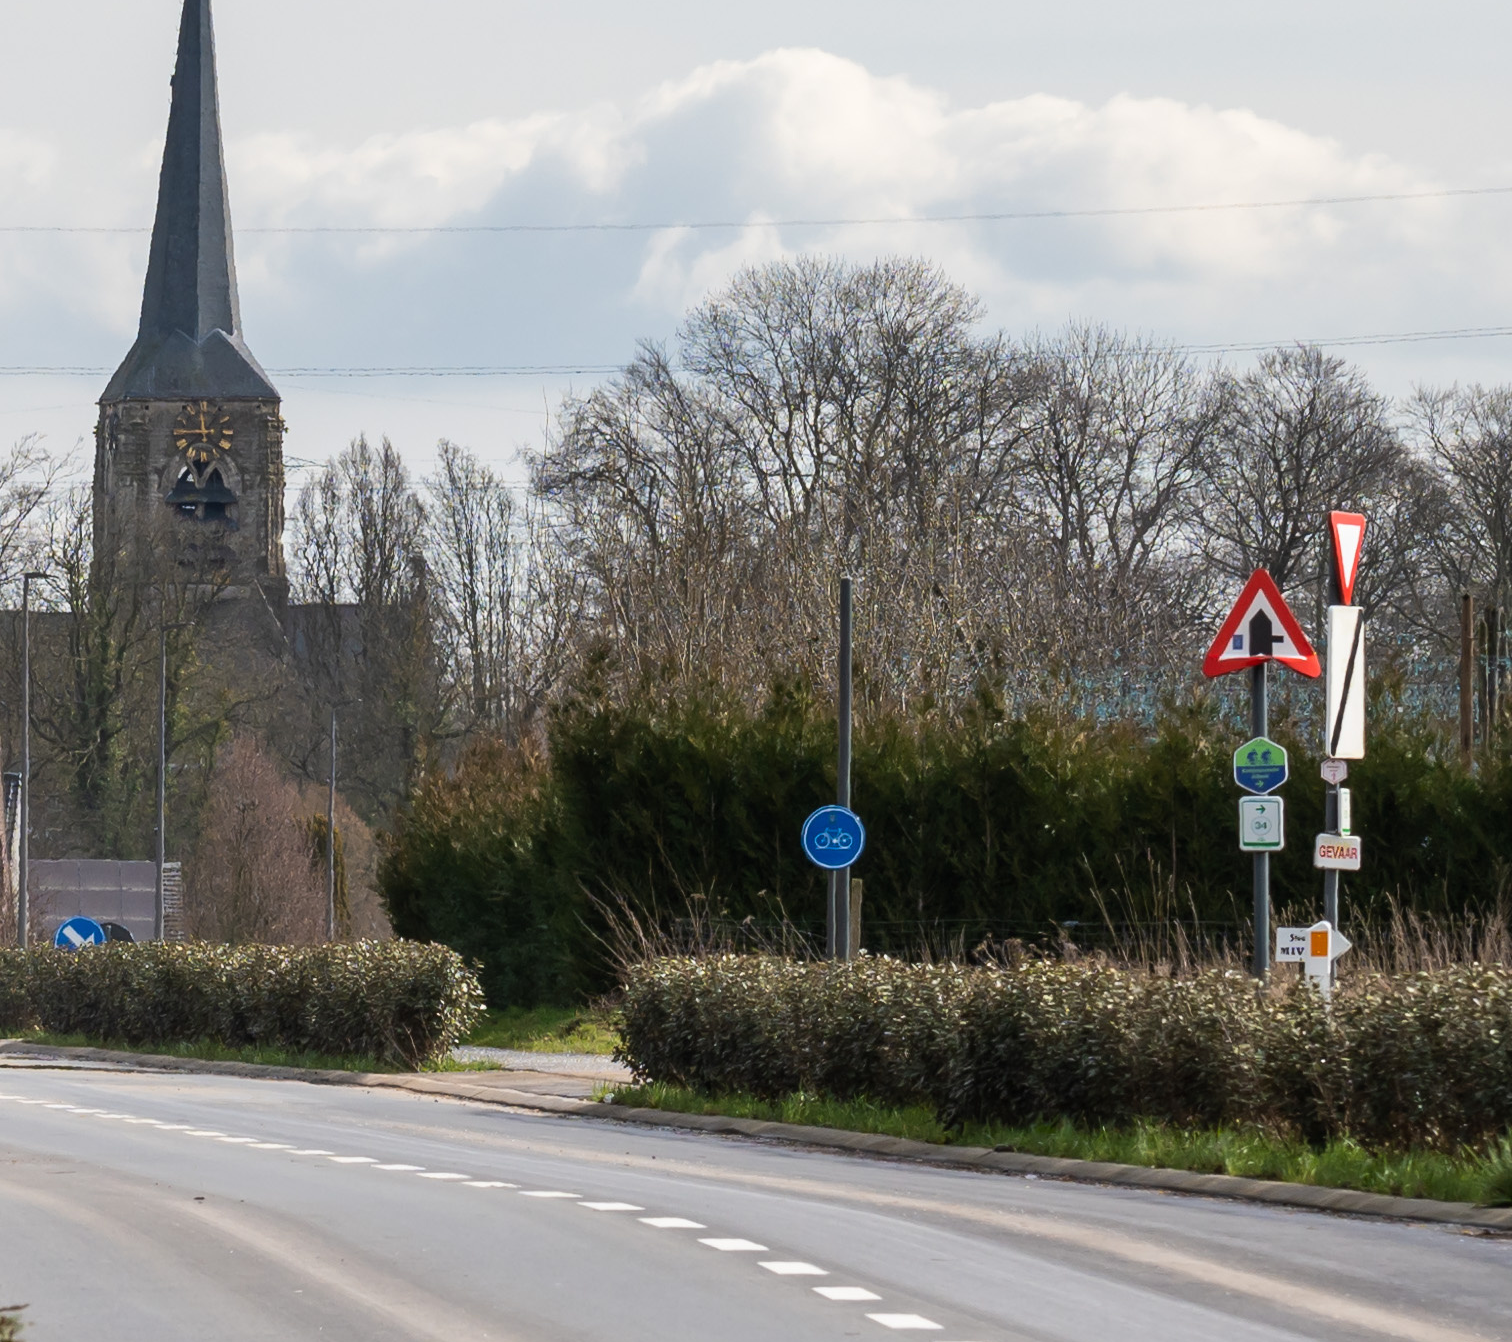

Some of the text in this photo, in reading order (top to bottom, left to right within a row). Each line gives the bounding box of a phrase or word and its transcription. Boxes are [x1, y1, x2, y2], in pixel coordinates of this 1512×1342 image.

[1255, 821, 1268, 830] 34
[1319, 845, 1358, 859] GEVAAR
[1280, 947, 1305, 956] MIV
